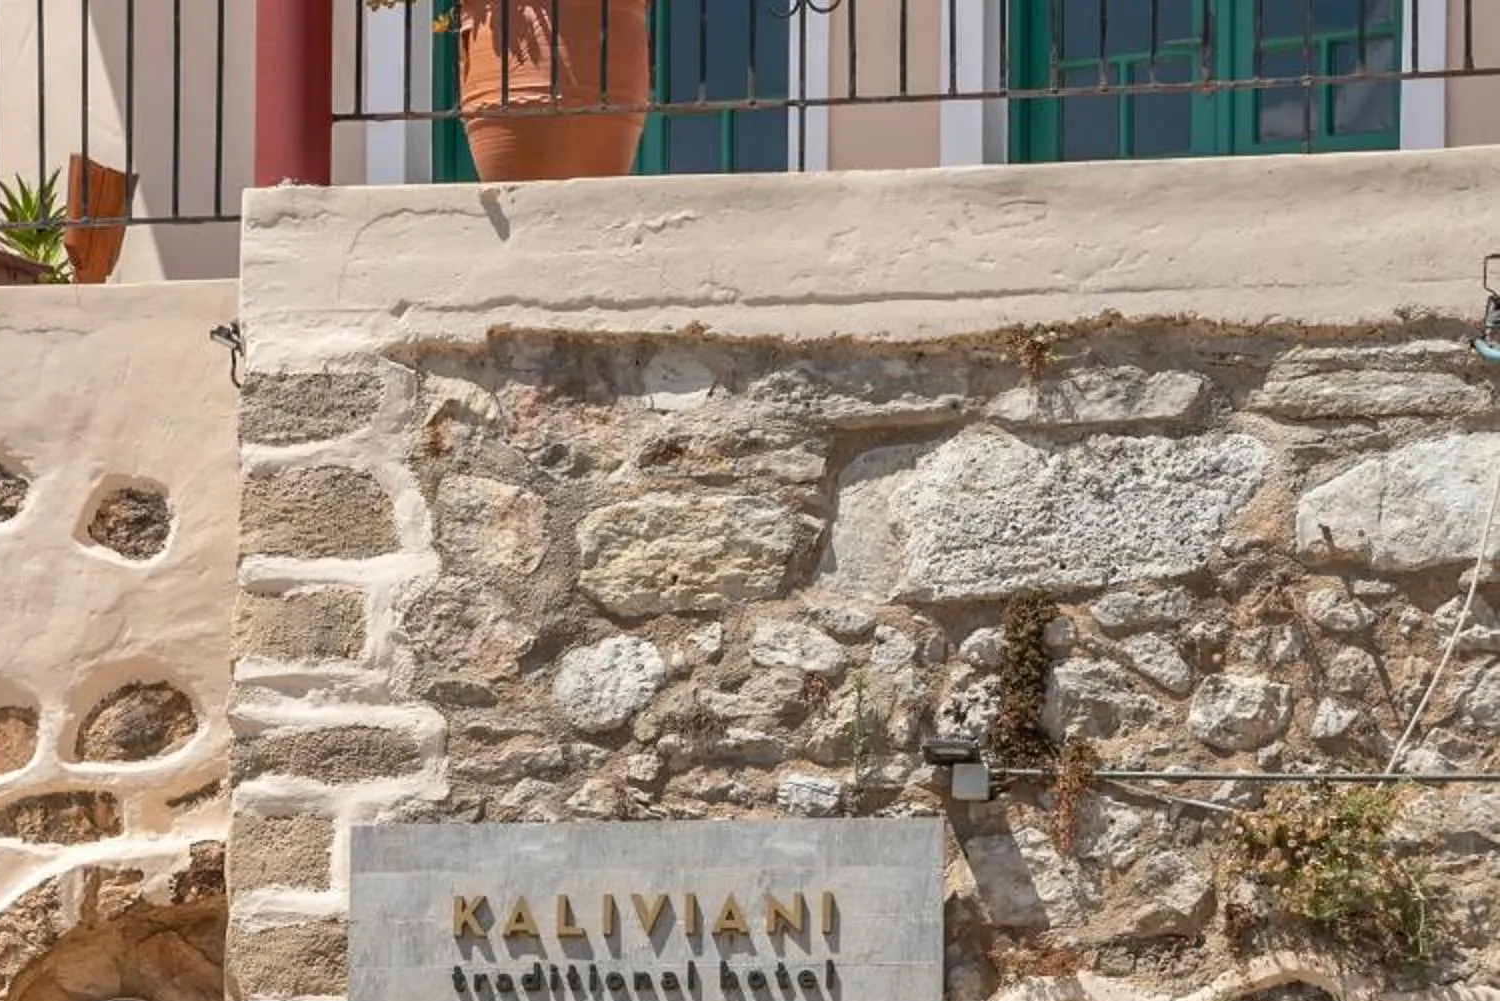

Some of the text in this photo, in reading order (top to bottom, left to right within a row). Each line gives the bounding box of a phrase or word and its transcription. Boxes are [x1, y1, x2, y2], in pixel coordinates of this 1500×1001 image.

[452, 890, 836, 938] KALIVIANI
[451, 958, 836, 995] traditional hotel
